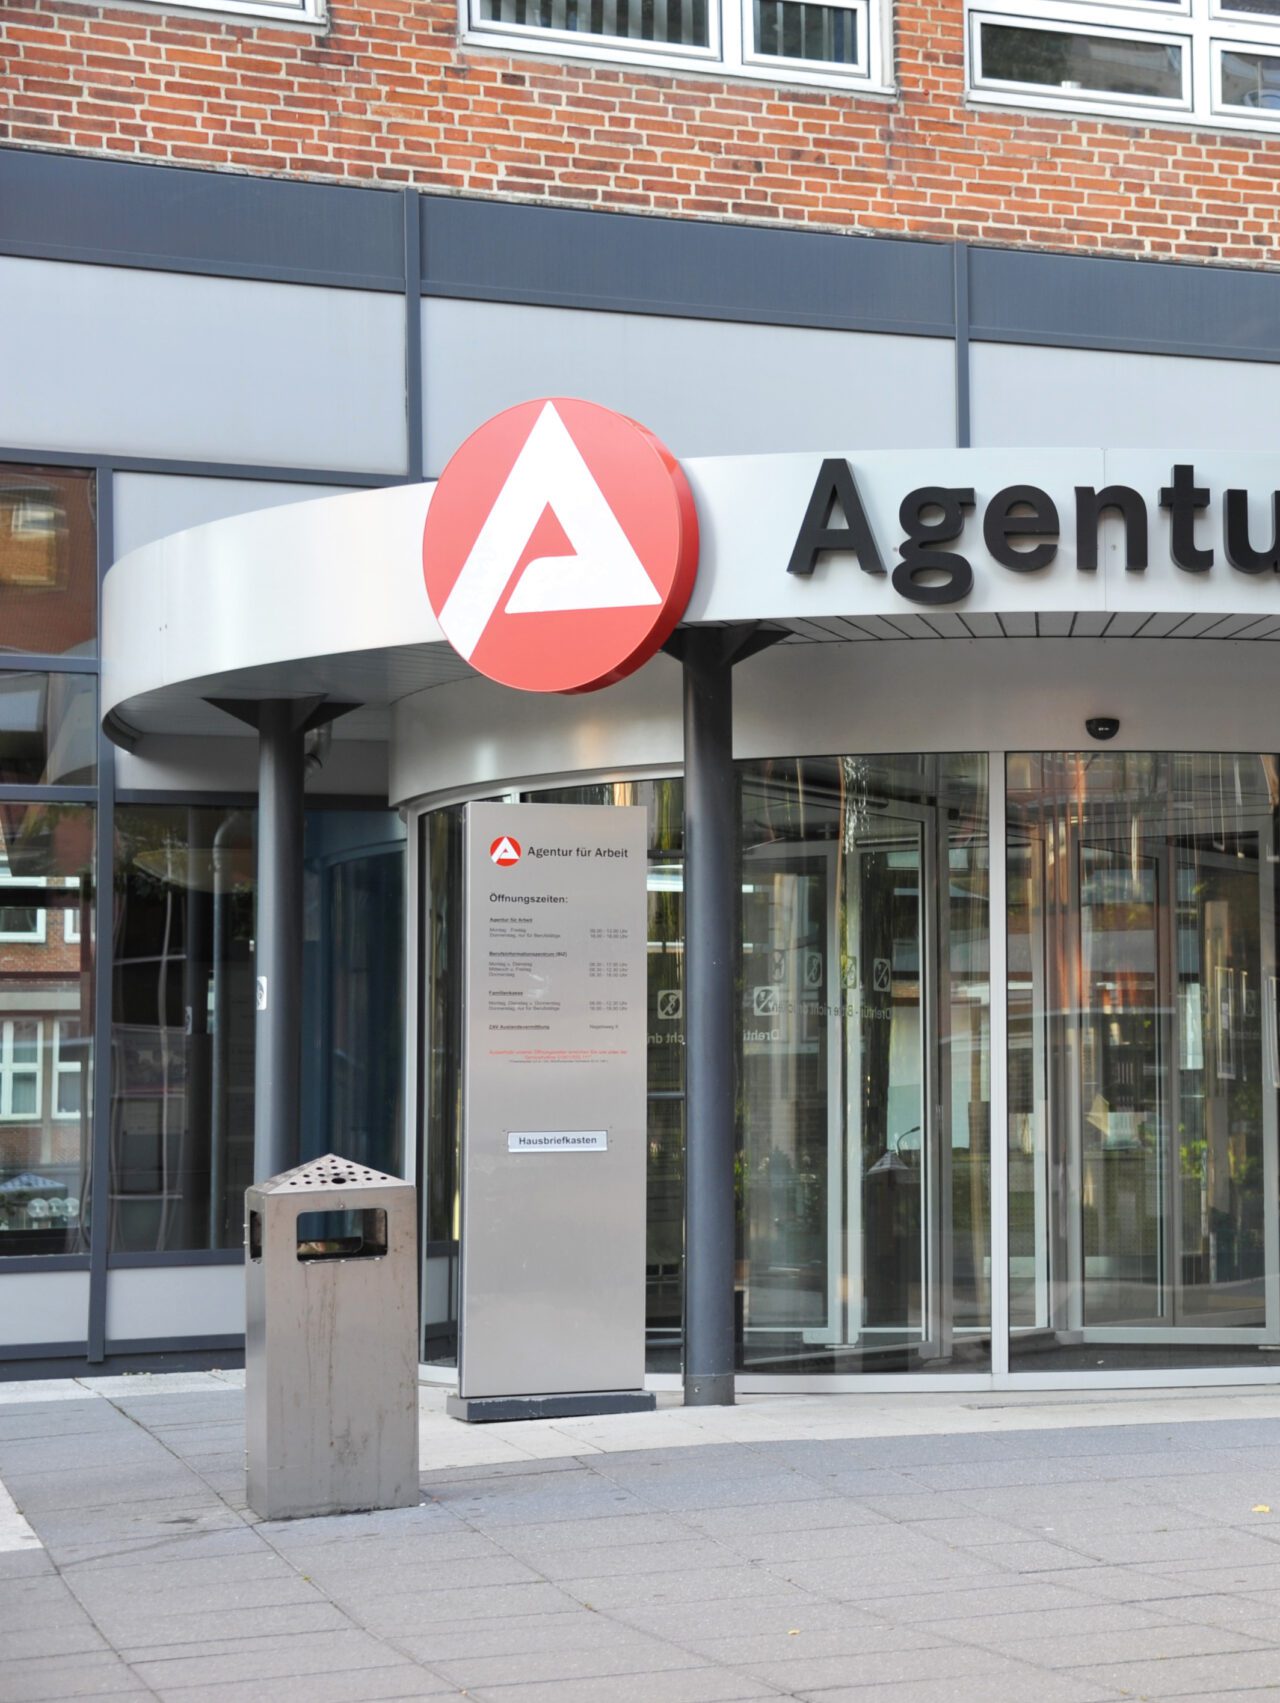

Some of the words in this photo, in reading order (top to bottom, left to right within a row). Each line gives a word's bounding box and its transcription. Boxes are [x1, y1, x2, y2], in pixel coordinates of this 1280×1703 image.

[527, 846, 573, 858] Agentur
[576, 847, 592, 858] für
[594, 847, 629, 858] Arbeit
[489, 893, 569, 905] Öffnungszeiten:
[518, 1136, 598, 1145] Hausbriefkasten
